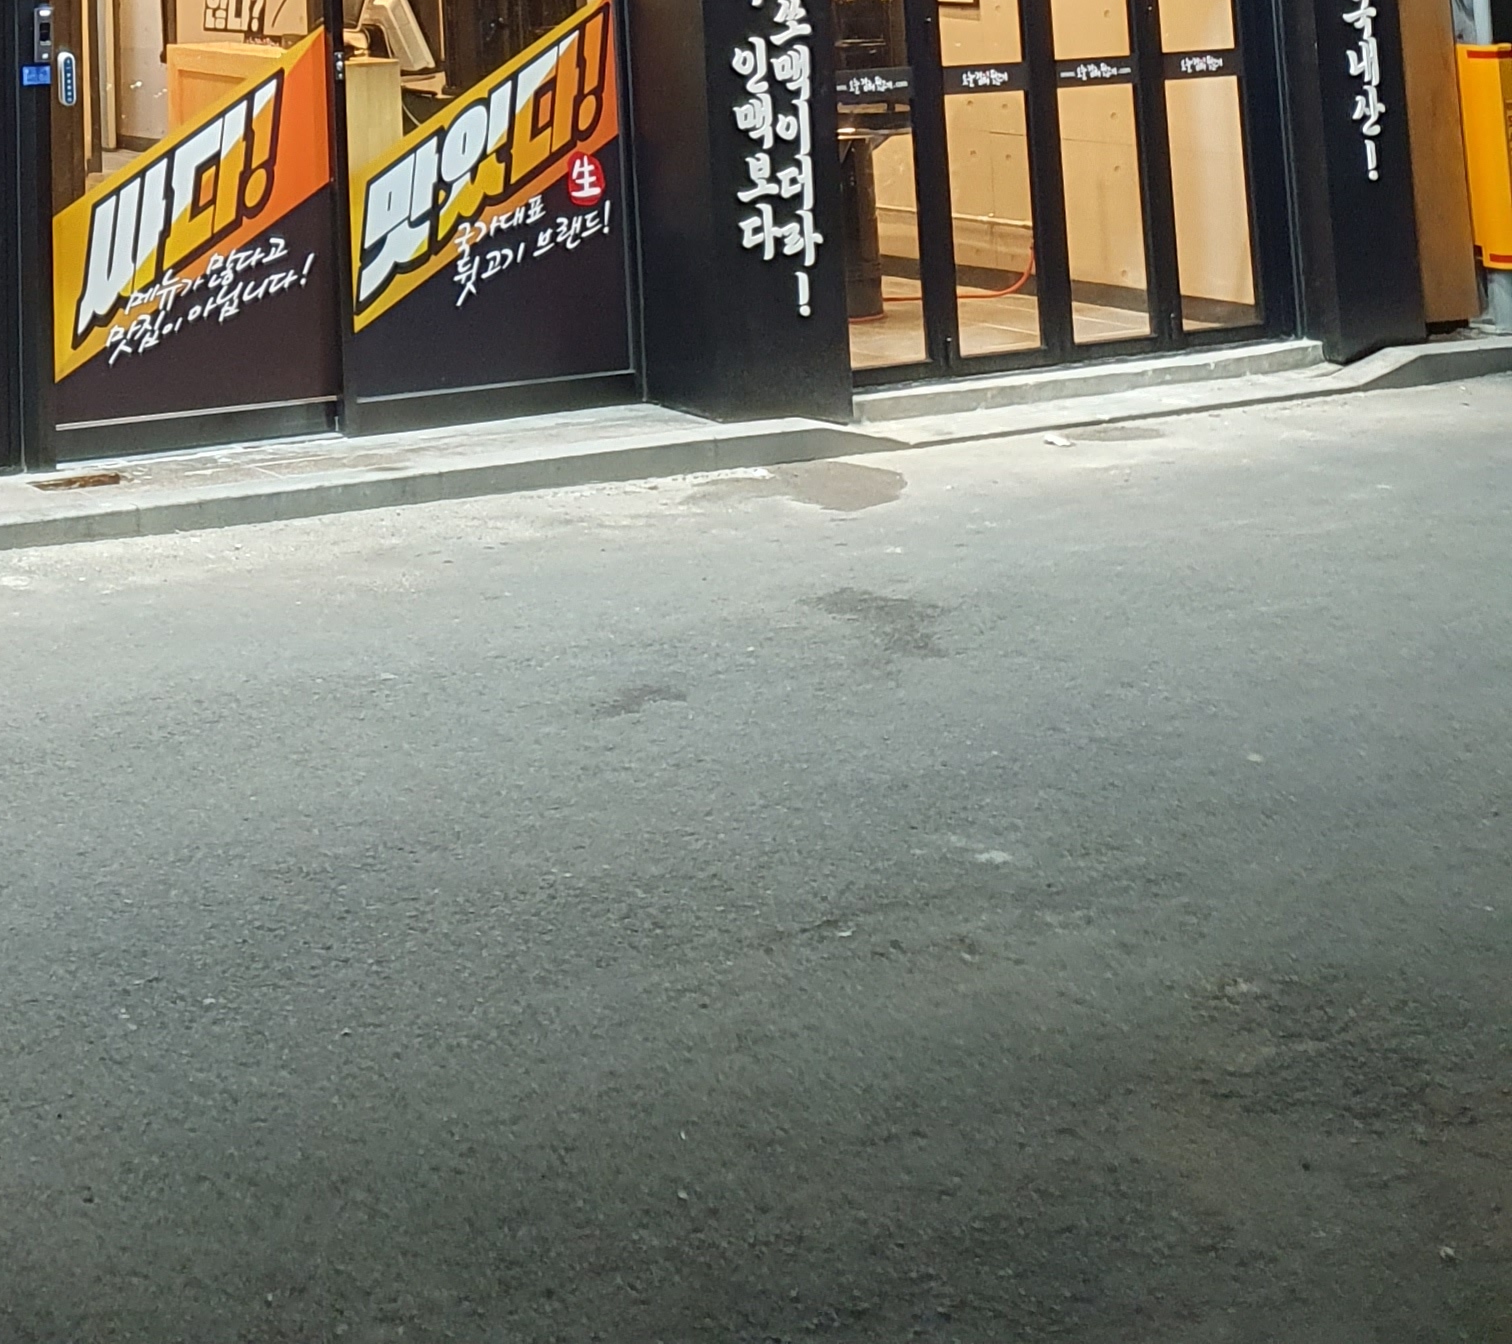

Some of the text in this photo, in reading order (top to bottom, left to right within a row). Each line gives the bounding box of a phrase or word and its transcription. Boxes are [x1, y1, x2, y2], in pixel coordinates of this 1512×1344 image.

[358, 10, 605, 304] 맛있다!
[731, 36, 785, 261] 인맥보다
[75, 76, 280, 340] 싸다!
[453, 200, 611, 307] 뒷고기 브랜드!
[454, 195, 546, 255] 국가대표
[105, 252, 316, 366] 맛집이 아닙니다!
[124, 237, 289, 316] 메뉴가 많다고
